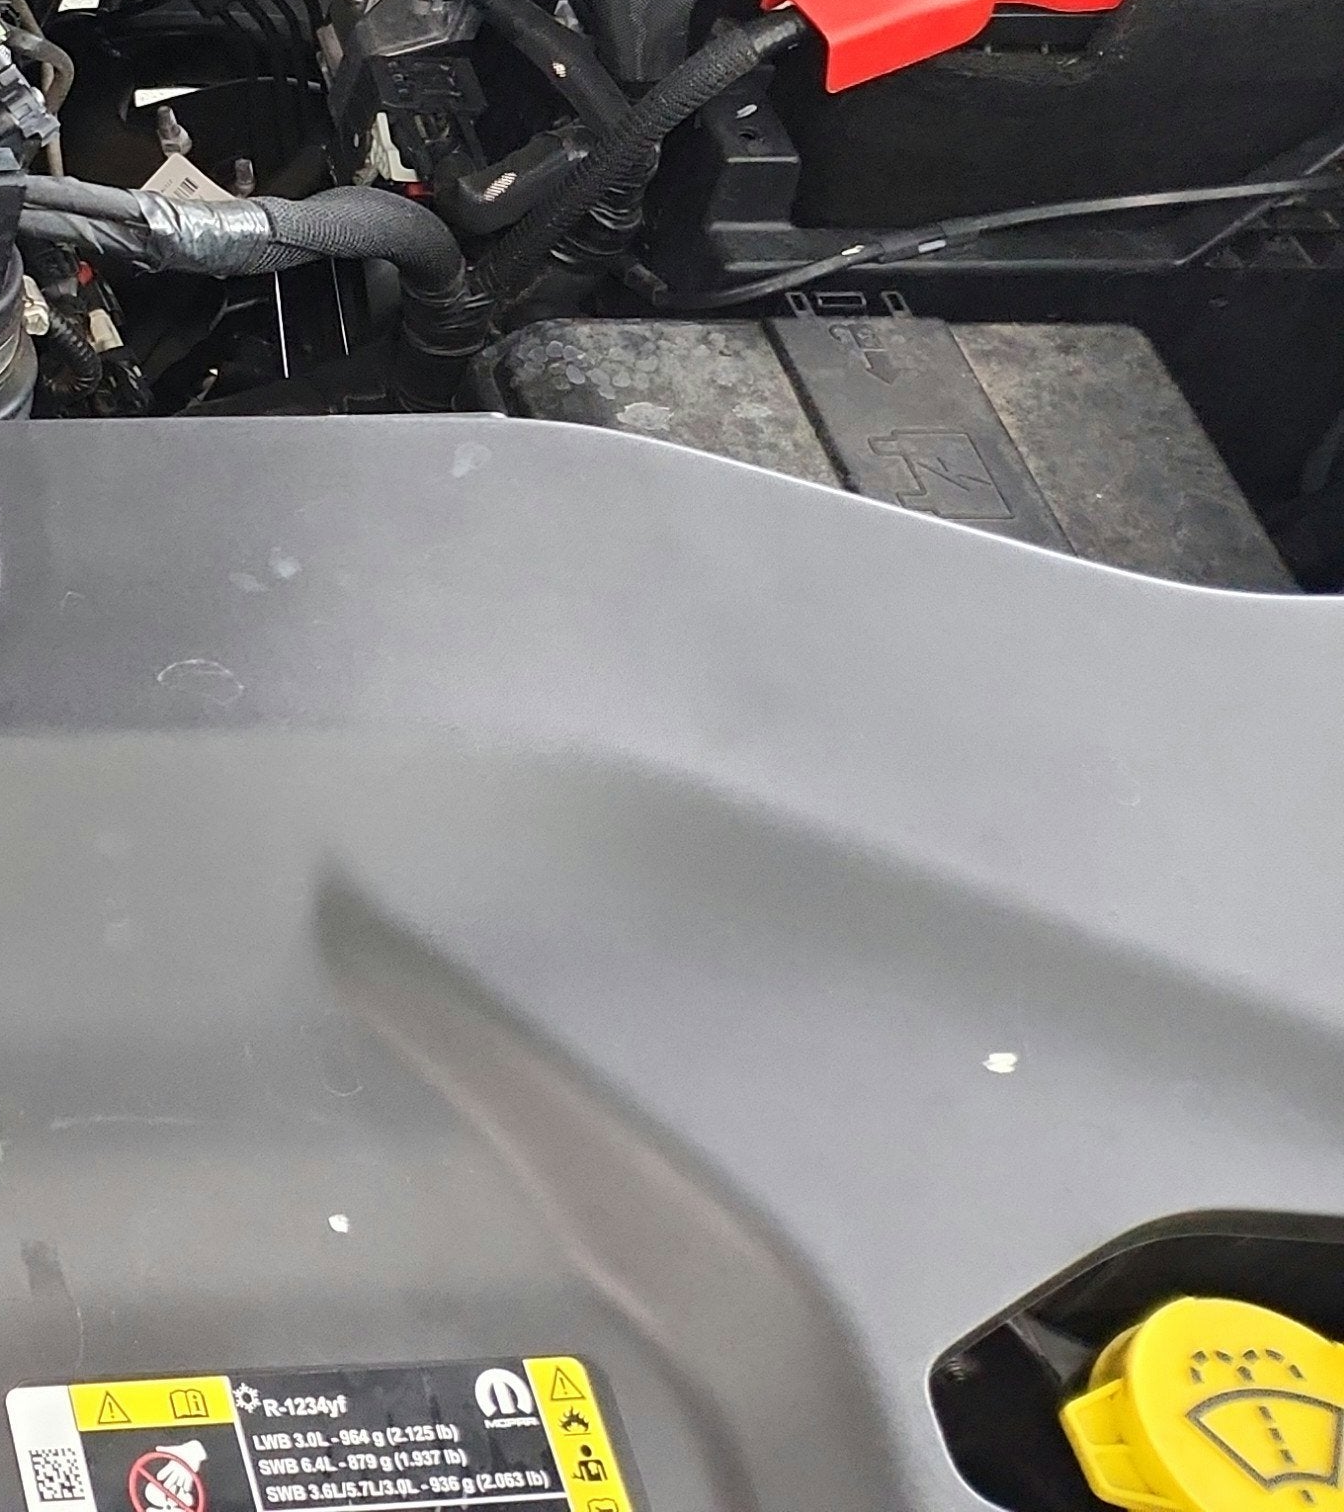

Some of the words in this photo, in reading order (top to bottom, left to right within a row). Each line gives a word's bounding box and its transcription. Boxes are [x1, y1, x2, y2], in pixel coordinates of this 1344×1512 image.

[263, 1394, 348, 1418] R-1234yf
[252, 1434, 292, 1451] LWB
[294, 1431, 329, 1449] 3.0L
[340, 1429, 370, 1446] 964
[372, 1432, 385, 1448] g
[386, 1424, 435, 1445] (2.125
[436, 1423, 459, 1443] lb)
[483, 1417, 540, 1429] MOPAR
[258, 1458, 299, 1476] SWB
[300, 1456, 338, 1473] 6.4L
[348, 1454, 378, 1471] 879
[380, 1457, 393, 1472] g
[394, 1450, 442, 1471] (1.937
[444, 1448, 468, 1468] lb)
[266, 1484, 307, 1503] SWB
[308, 1478, 419, 1501] 3.6L/5.7L/3.0L
[430, 1476, 461, 1493] 936
[462, 1479, 475, 1494] g
[476, 1471, 524, 1493] (2.063
[527, 1470, 551, 1489] lb)
